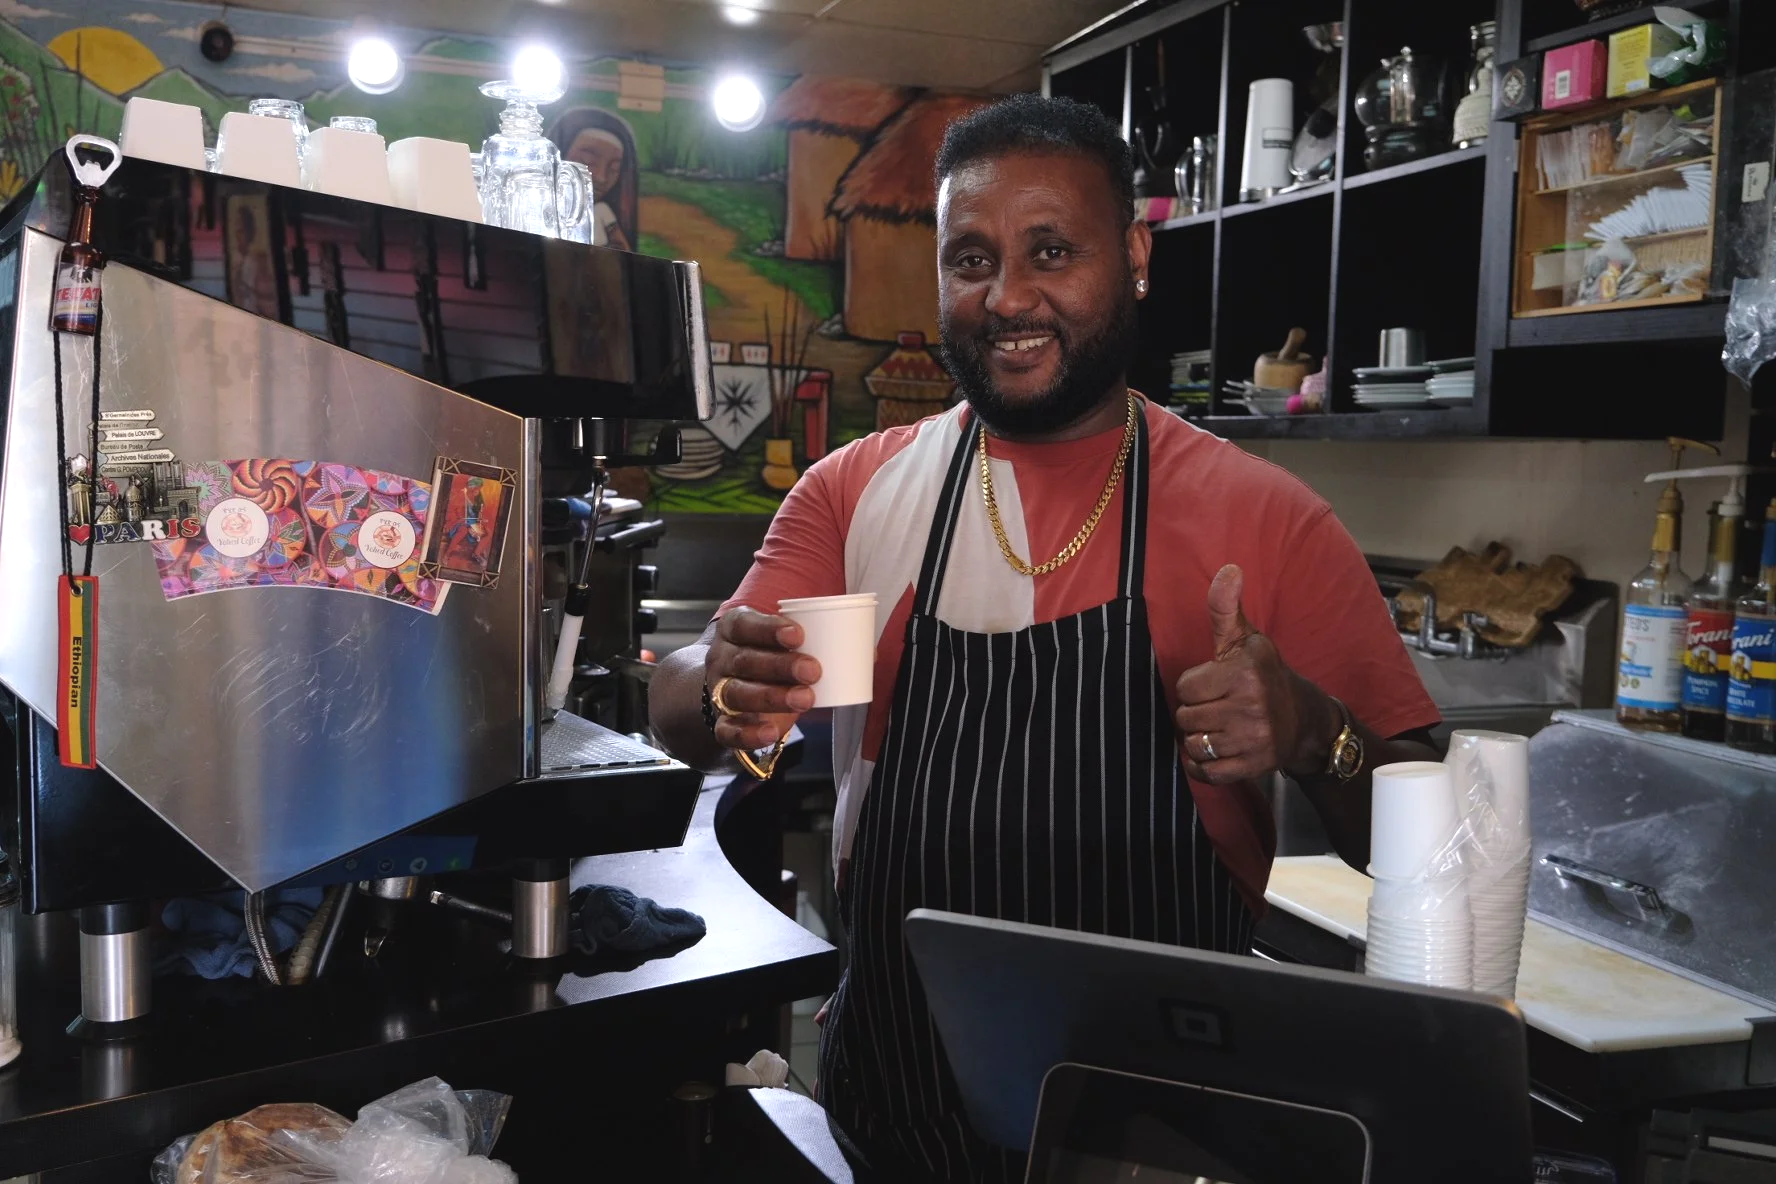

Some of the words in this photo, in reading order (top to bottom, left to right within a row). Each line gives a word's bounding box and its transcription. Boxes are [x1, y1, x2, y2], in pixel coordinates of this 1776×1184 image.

[137, 452, 170, 460] Nationales
[93, 517, 201, 545] PARIS
[386, 549, 404, 560] Coffee
[70, 636, 82, 708] Ethiopian
